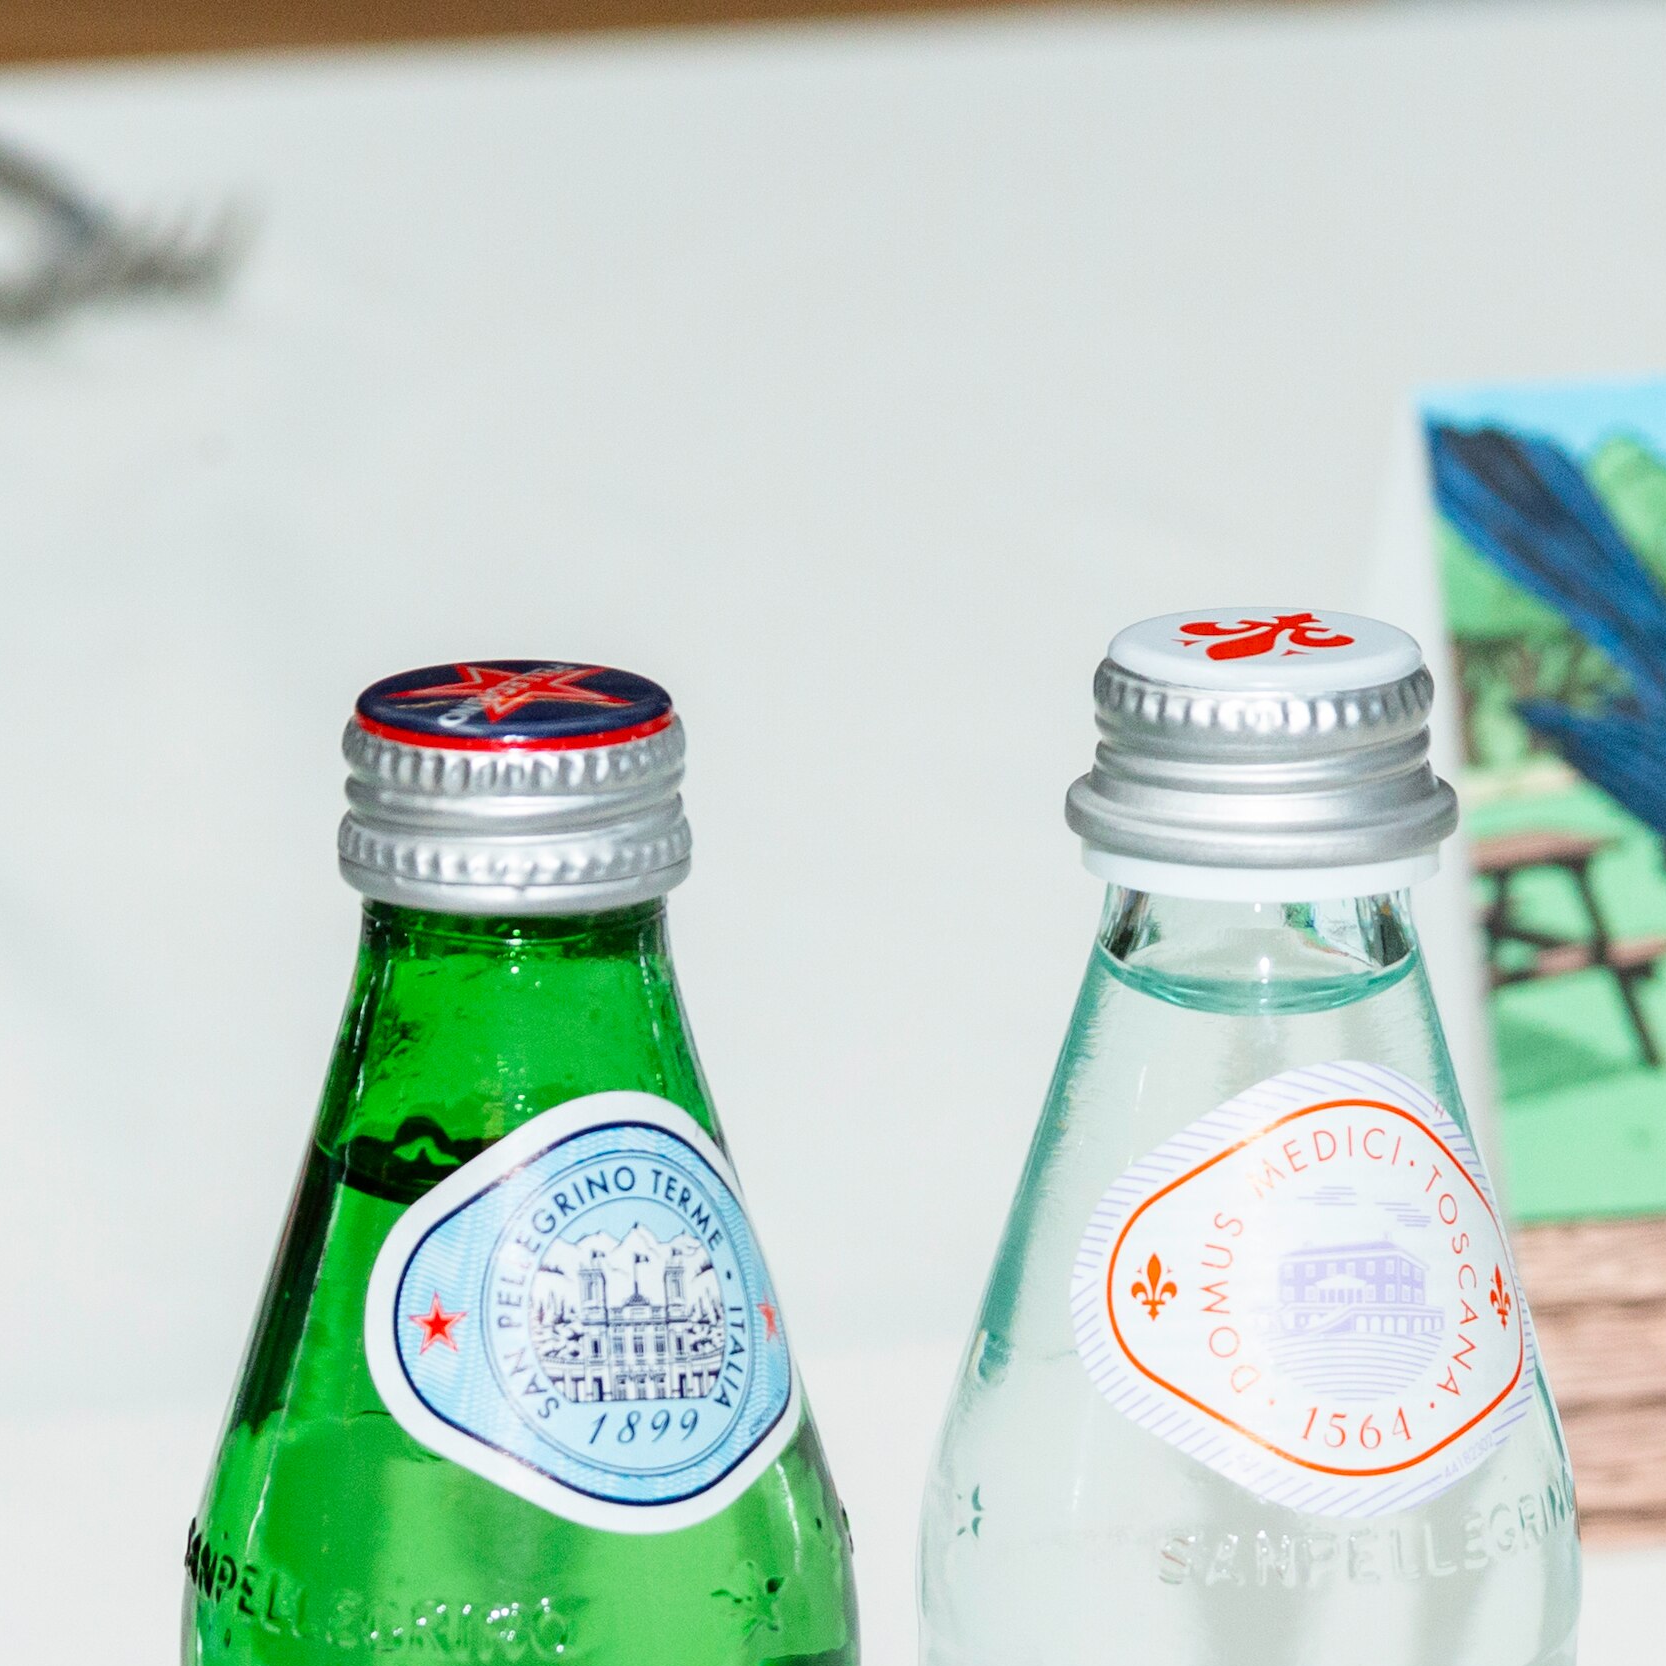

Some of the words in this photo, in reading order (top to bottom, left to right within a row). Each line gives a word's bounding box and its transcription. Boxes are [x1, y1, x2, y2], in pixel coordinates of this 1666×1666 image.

[1245, 1126, 1402, 1199] MEDICI
[651, 1168, 724, 1251] TERME
[1425, 1164, 1479, 1396] TOSCANA
[713, 1305, 746, 1410] ITALIA
[588, 1408, 700, 1446] 1899
[1300, 1406, 1413, 1450] 1564
